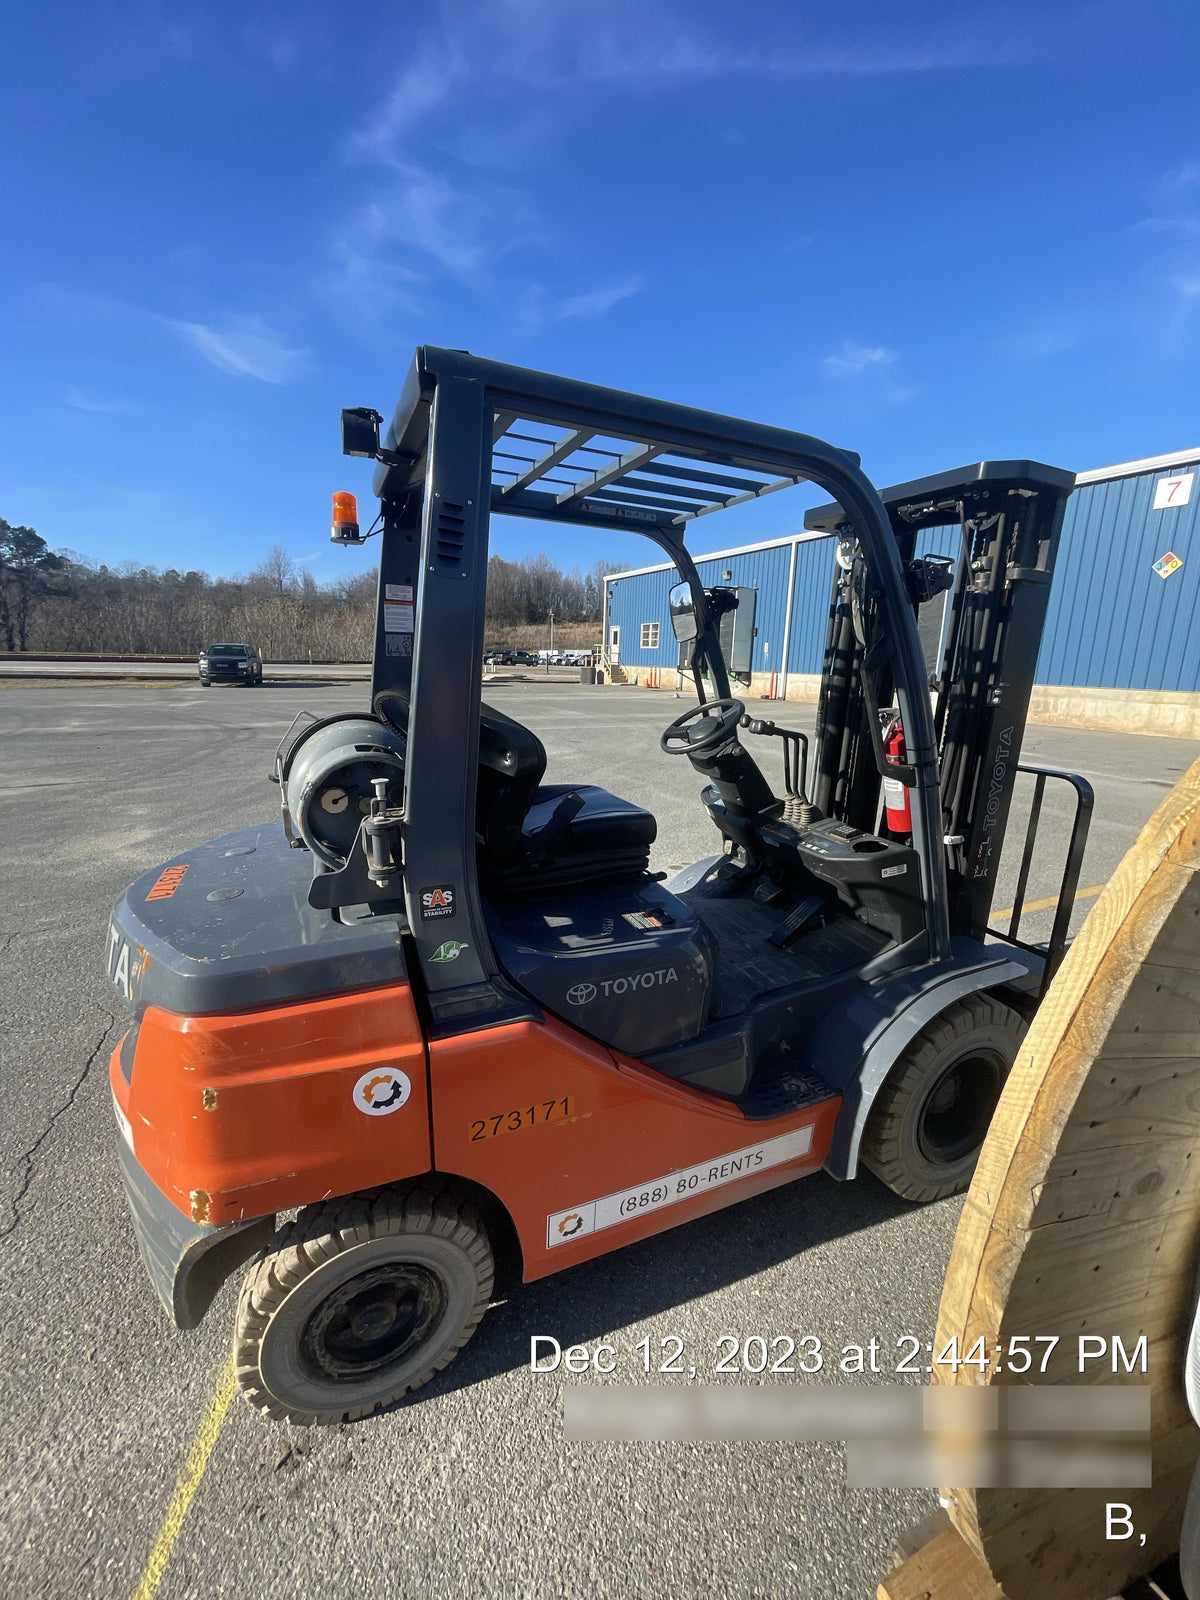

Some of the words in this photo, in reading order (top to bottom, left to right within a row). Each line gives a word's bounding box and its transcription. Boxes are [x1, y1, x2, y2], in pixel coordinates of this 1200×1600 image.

[1167, 481, 1182, 503] 7
[983, 725, 1014, 832] TOYOTA
[422, 888, 453, 908] SAS
[423, 909, 453, 918] STABILITY
[600, 967, 679, 997] TOYOTA
[471, 1096, 569, 1142] 273171
[618, 1184, 669, 1216] (888)
[676, 1150, 764, 1194] 80-RENTS
